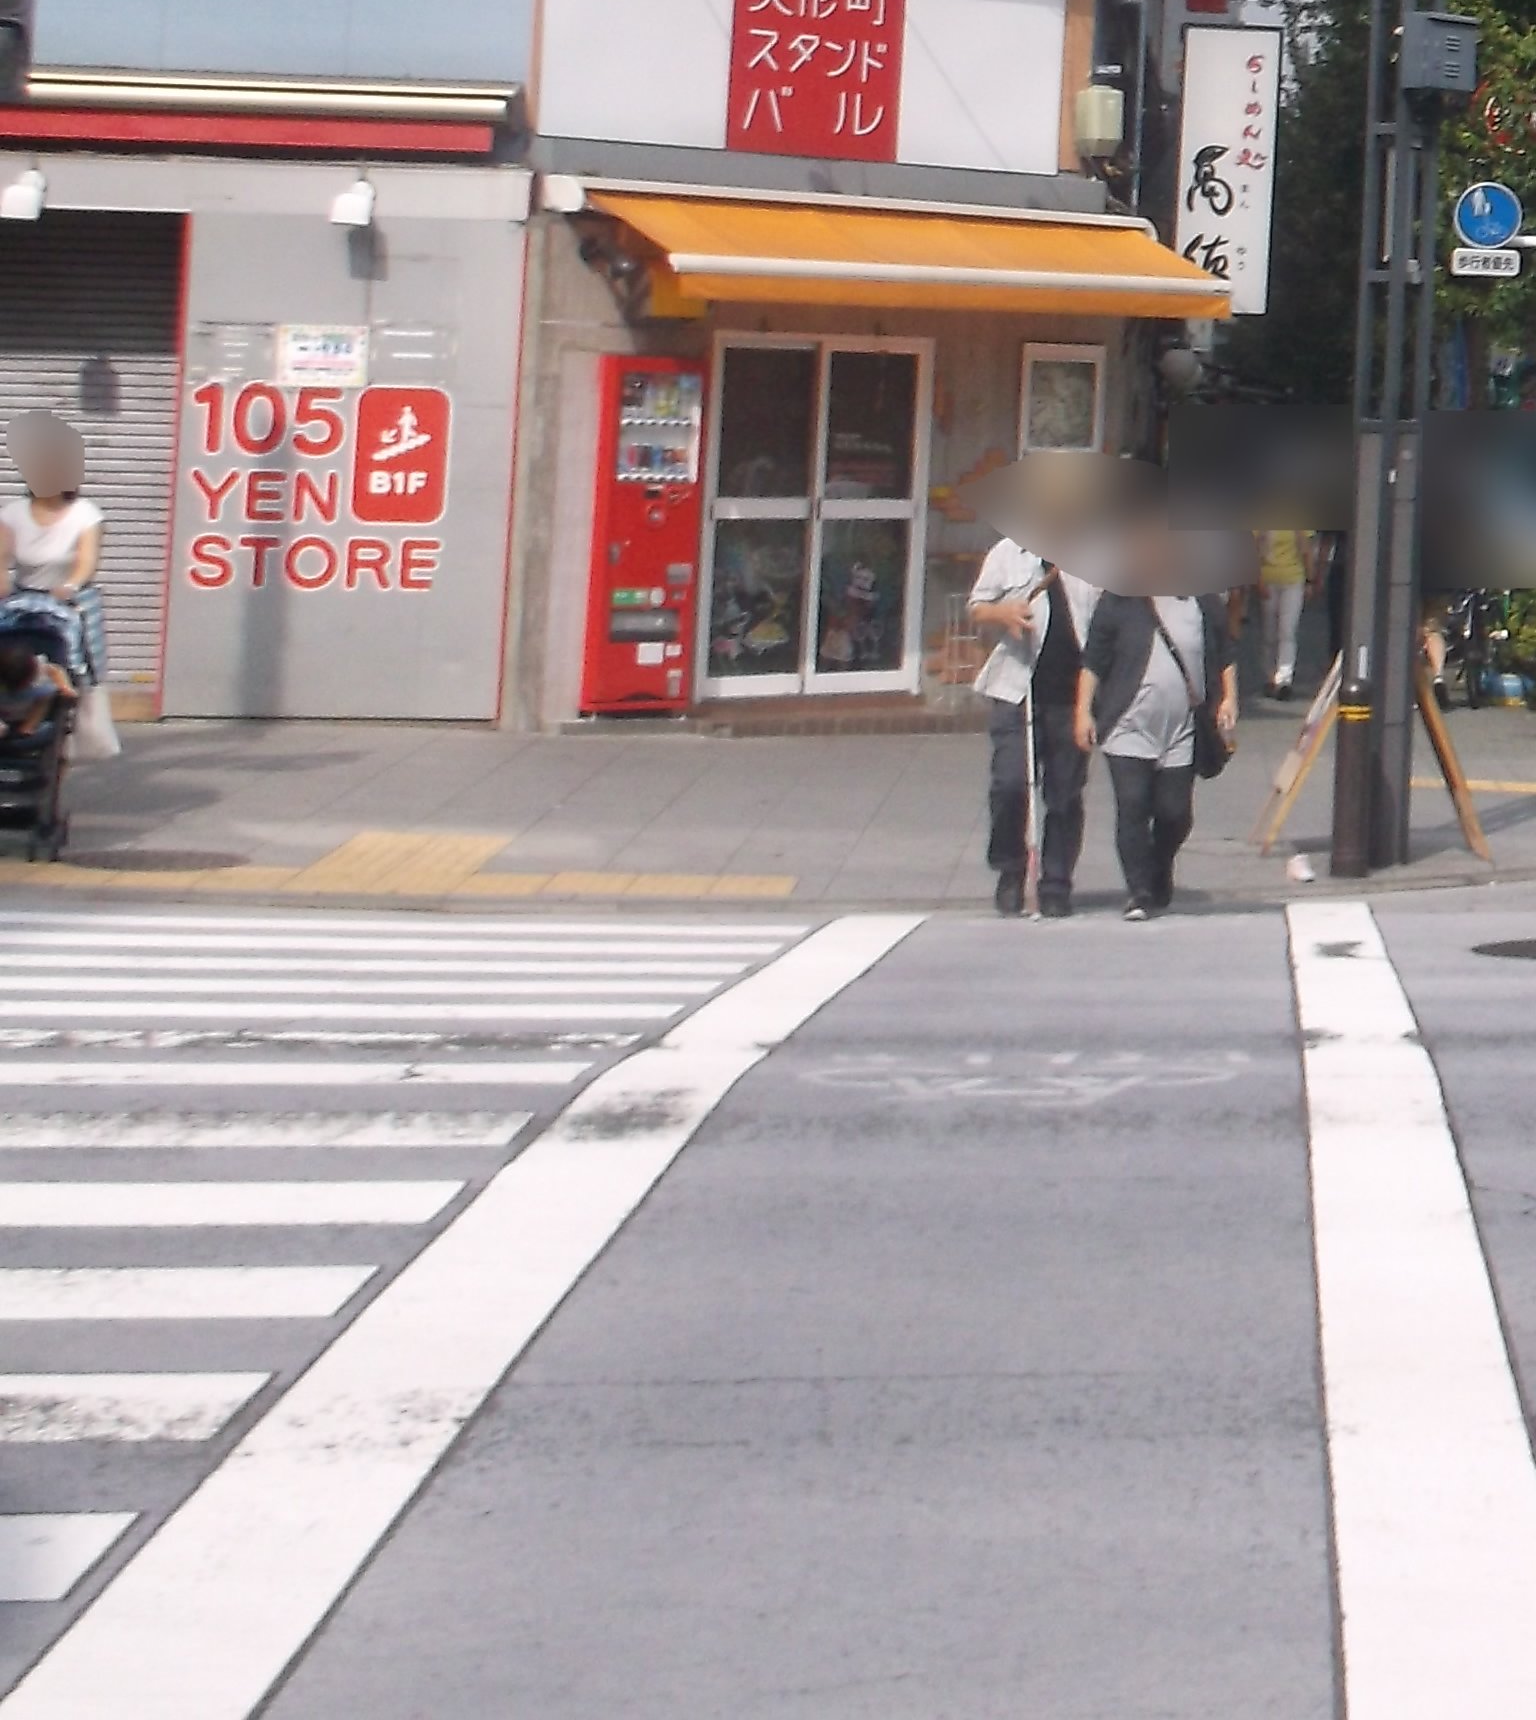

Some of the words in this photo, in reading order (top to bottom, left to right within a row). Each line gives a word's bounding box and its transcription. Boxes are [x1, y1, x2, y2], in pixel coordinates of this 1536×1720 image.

[745, 28, 888, 83] スタンド
[191, 381, 347, 457] 105
[191, 469, 338, 524] YEN
[369, 469, 429, 495] B1F
[187, 535, 443, 592] STORE
